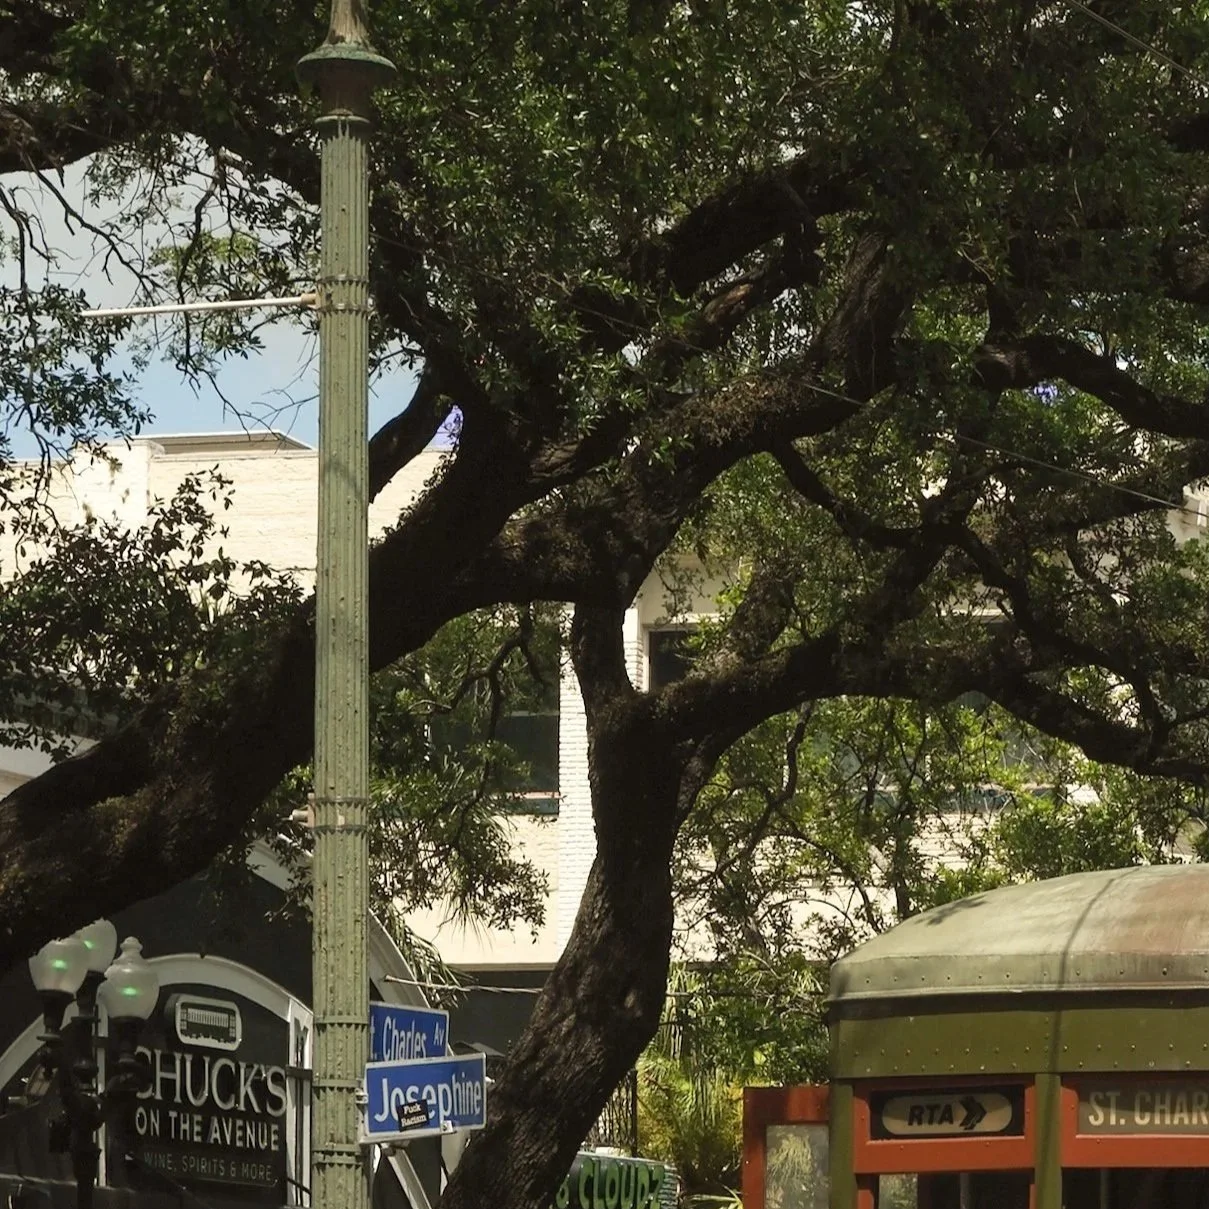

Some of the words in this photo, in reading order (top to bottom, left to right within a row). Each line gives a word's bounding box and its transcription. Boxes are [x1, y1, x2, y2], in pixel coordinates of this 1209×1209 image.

[383, 1016, 427, 1061] Charles
[433, 1022, 445, 1046] Av
[401, 1115, 427, 1127] Racism
[404, 1104, 421, 1115] Fuck
[908, 1104, 954, 1126] RTA
[1088, 1093, 1125, 1127] ST.
[135, 1107, 160, 1136] ON
[169, 1110, 202, 1142] THE
[209, 1116, 279, 1151] AVENUE
[182, 1155, 225, 1176] SPIRITS
[230, 1162, 238, 1178] &
[241, 1164, 272, 1181] MORE
